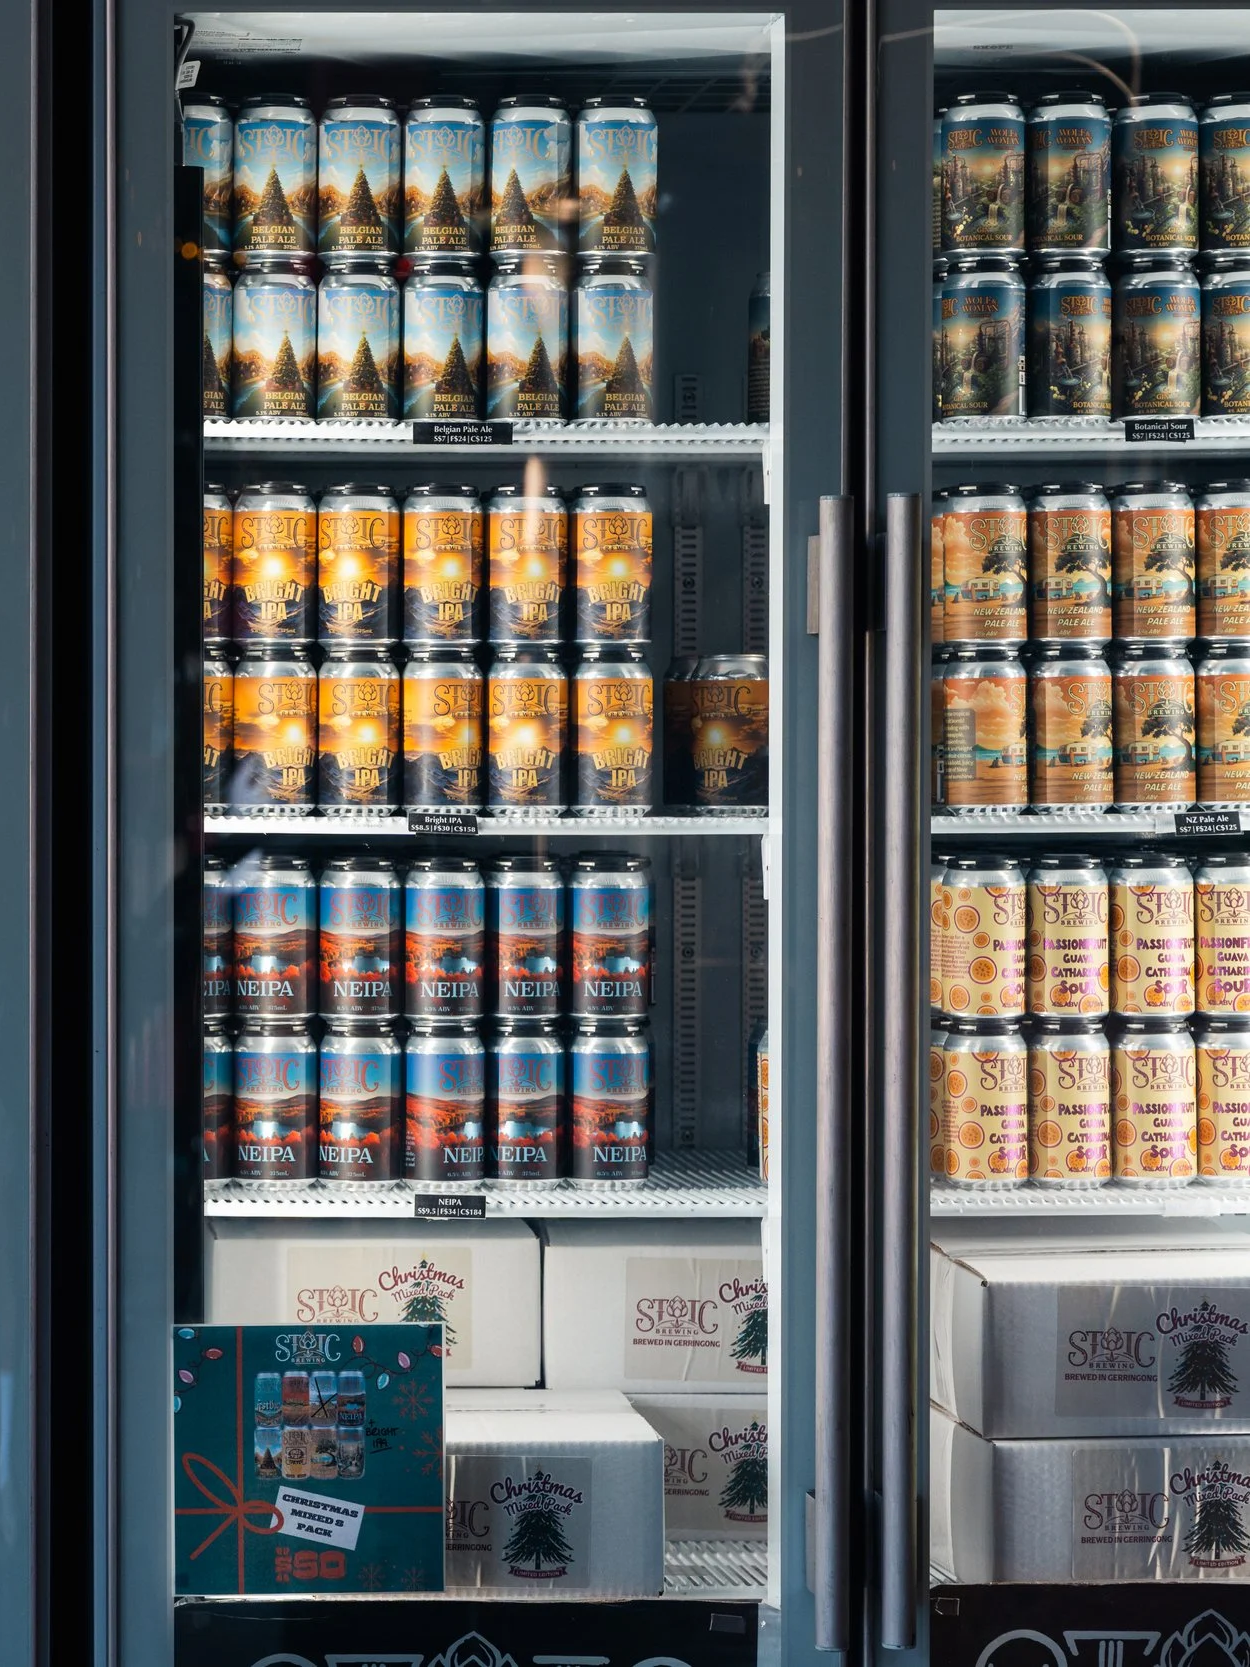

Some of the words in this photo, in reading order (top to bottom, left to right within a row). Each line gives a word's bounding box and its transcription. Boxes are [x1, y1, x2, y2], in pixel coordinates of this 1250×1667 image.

[252, 225, 295, 234] BELGIAN
[956, 234, 994, 242] BOTANICAL
[251, 235, 275, 244] PALE
[277, 236, 297, 244] ALE
[434, 425, 461, 435] Belgian
[462, 425, 478, 433] Pale
[480, 425, 493, 433] Ale
[1134, 422, 1169, 430] Botanical
[244, 580, 305, 603] BRIGHT
[587, 580, 647, 604] BRIGHT
[261, 602, 287, 620] IPA
[605, 602, 631, 621] IPA
[1158, 605, 1191, 613] ZEALAND
[424, 816, 447, 825] Bright
[1185, 816, 1198, 824] NZ
[1199, 815, 1215, 823] Pale
[1216, 814, 1229, 822] Ale
[1043, 938, 1107, 950] PASSIONFRUIT
[1063, 953, 1094, 963] GUAVA
[1051, 967, 1101, 978] CATHARINA
[420, 981, 479, 998] NEIPA
[1058, 980, 1096, 994] SOUR
[438, 1198, 462, 1206] NEIPA
[378, 1262, 465, 1292] Christmas
[391, 1285, 425, 1303] Mixed
[428, 1284, 455, 1301] Pack
[719, 1278, 768, 1303] Chris
[731, 1295, 768, 1315] Mixed
[1156, 1304, 1249, 1335] Christmas
[633, 1338, 664, 1346] BREWED
[673, 1339, 721, 1348] GERRINGONG
[1169, 1327, 1207, 1347] Mixed
[1209, 1328, 1238, 1347] Pack
[1064, 1373, 1098, 1381] BREWED
[1107, 1374, 1158, 1382] GERRINGONG
[365, 1426, 398, 1437] BRIGHT
[708, 1425, 768, 1452] Christ
[721, 1446, 757, 1464] Mixed
[1169, 1463, 1250, 1495] Christma
[490, 1473, 584, 1504] Christmas
[1182, 1486, 1220, 1507] Mixed
[282, 1494, 359, 1519] CHRISTMAS
[503, 1496, 542, 1516] Mixed
[544, 1497, 572, 1516] Pack
[290, 1508, 334, 1525] MIXED
[335, 1519, 344, 1528] 8
[296, 1522, 333, 1538] PACK
[1081, 1536, 1113, 1544] BREWED
